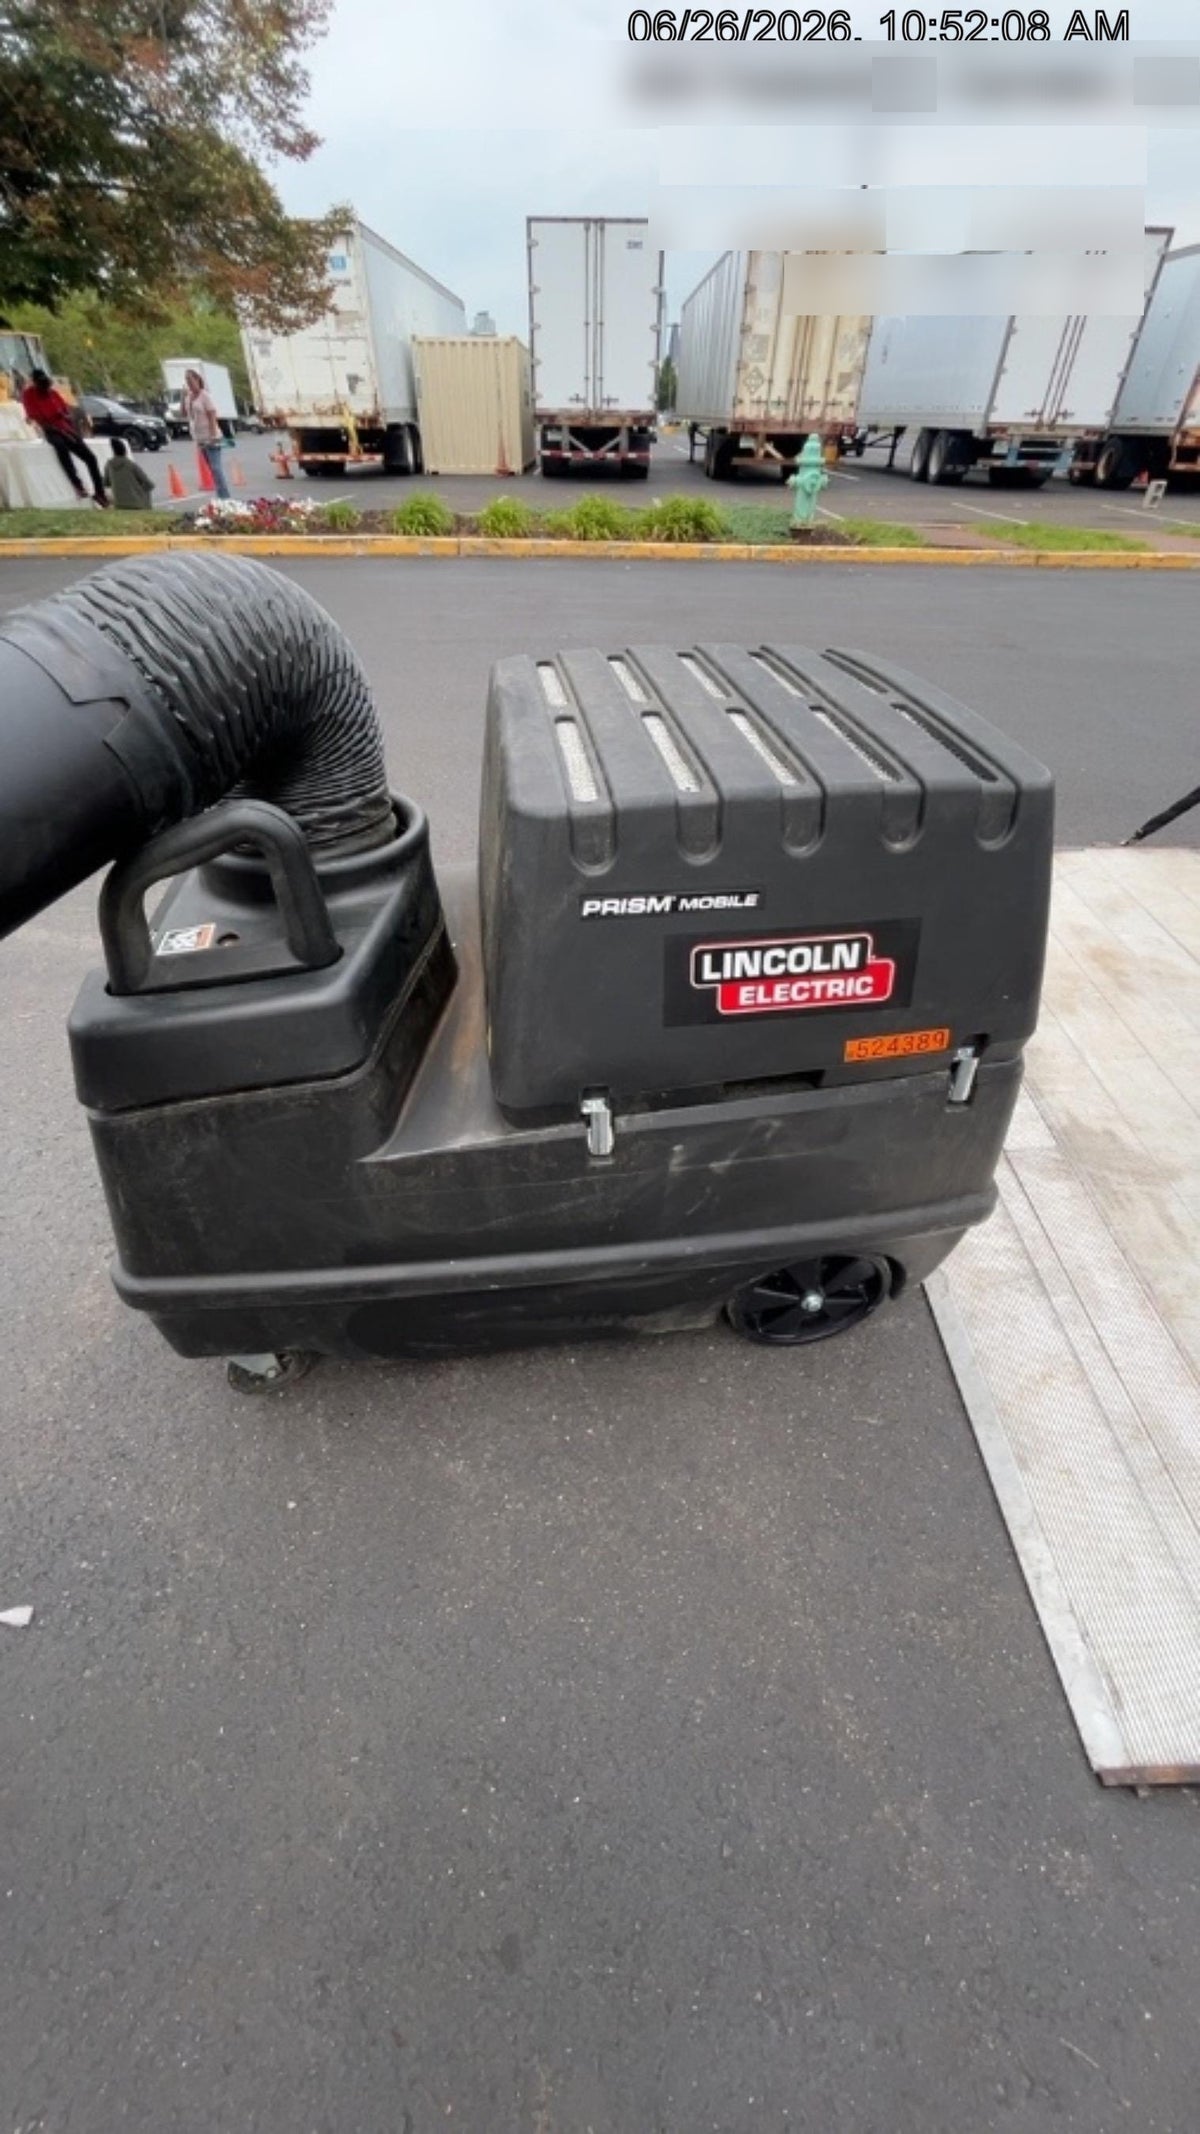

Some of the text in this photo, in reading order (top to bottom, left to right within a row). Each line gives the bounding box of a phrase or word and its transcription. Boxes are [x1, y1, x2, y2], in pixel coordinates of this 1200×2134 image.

[678, 894, 759, 911] MOBILE
[702, 942, 860, 981] LINCOLN
[738, 976, 874, 1006] ELECTRIC
[855, 1031, 945, 1058] 524389
